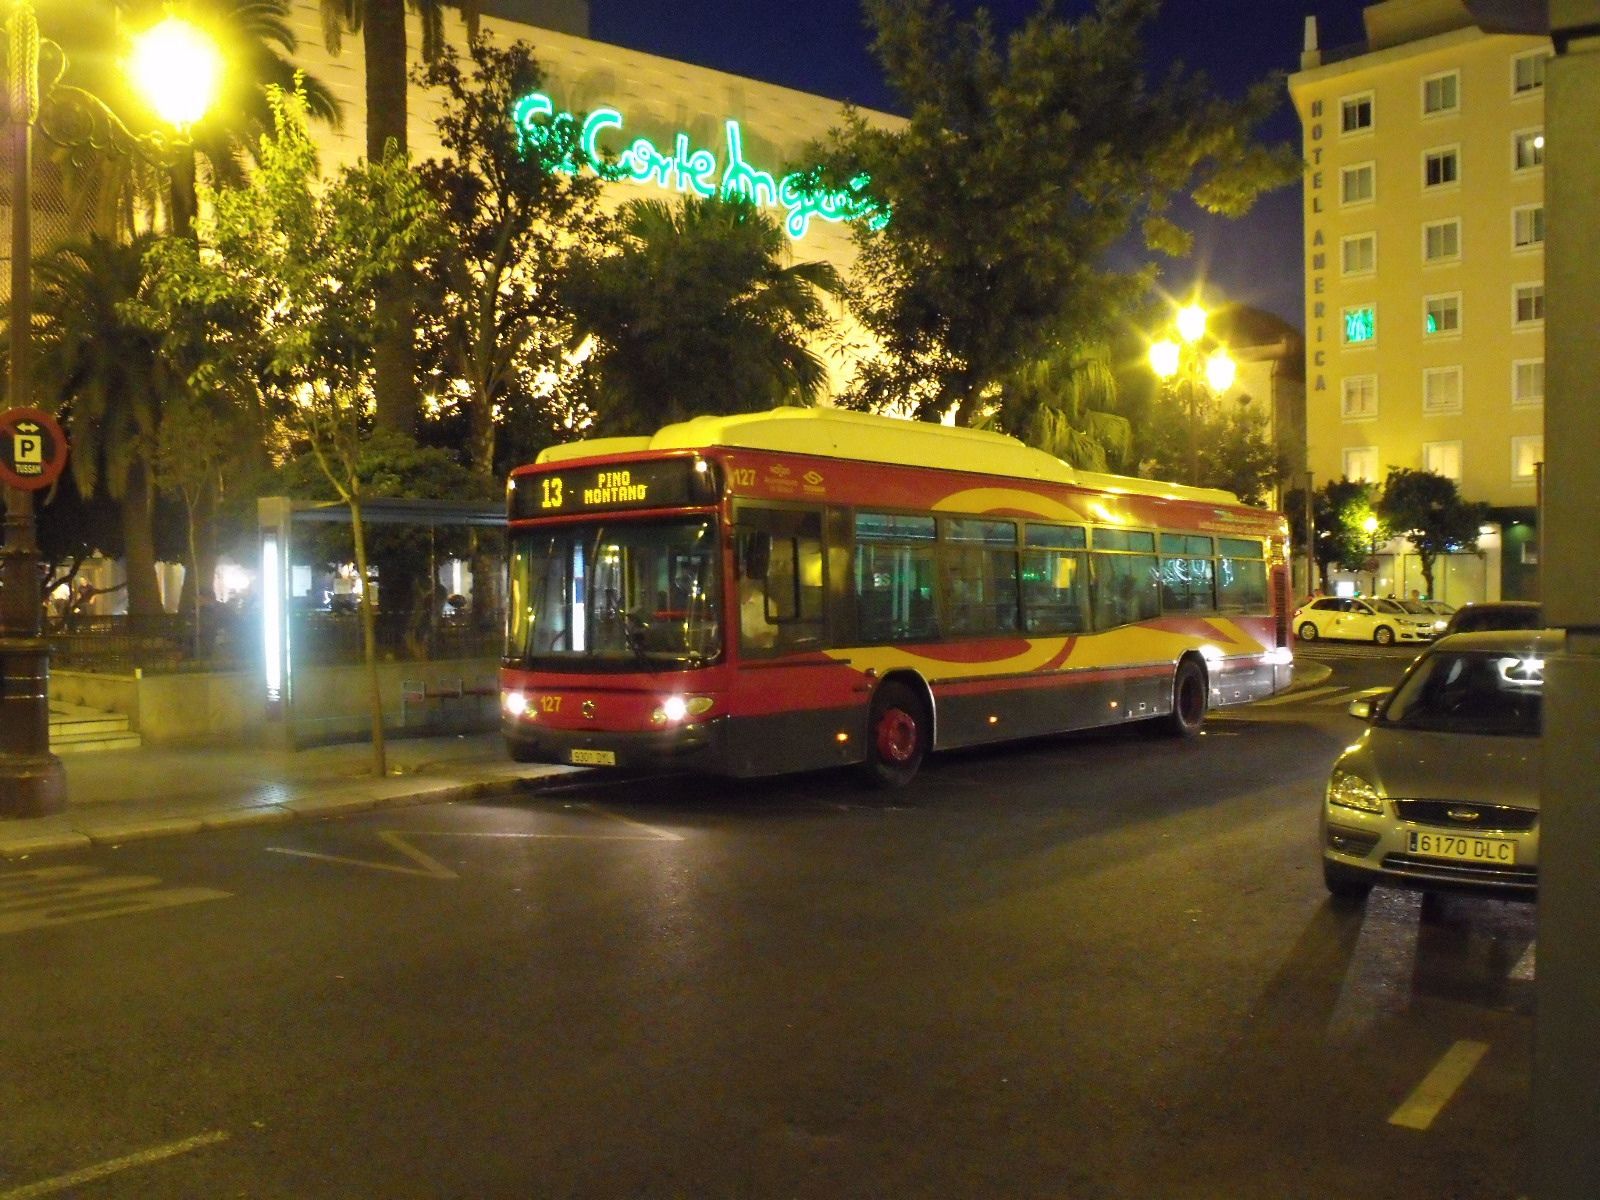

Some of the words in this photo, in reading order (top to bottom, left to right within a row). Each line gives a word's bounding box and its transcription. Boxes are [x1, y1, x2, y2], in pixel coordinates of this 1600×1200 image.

[579, 108, 716, 199] Corte
[1311, 100, 1324, 214] HOTEL
[1313, 228, 1327, 392] AMERICA
[21, 439, 35, 458] P
[598, 471, 631, 488] PINO
[733, 468, 756, 486] 127
[542, 478, 563, 508] 13
[584, 484, 647, 504] MONTANO
[541, 695, 562, 712] 127
[1420, 835, 1467, 855] 6170
[1474, 840, 1509, 861] DLC
